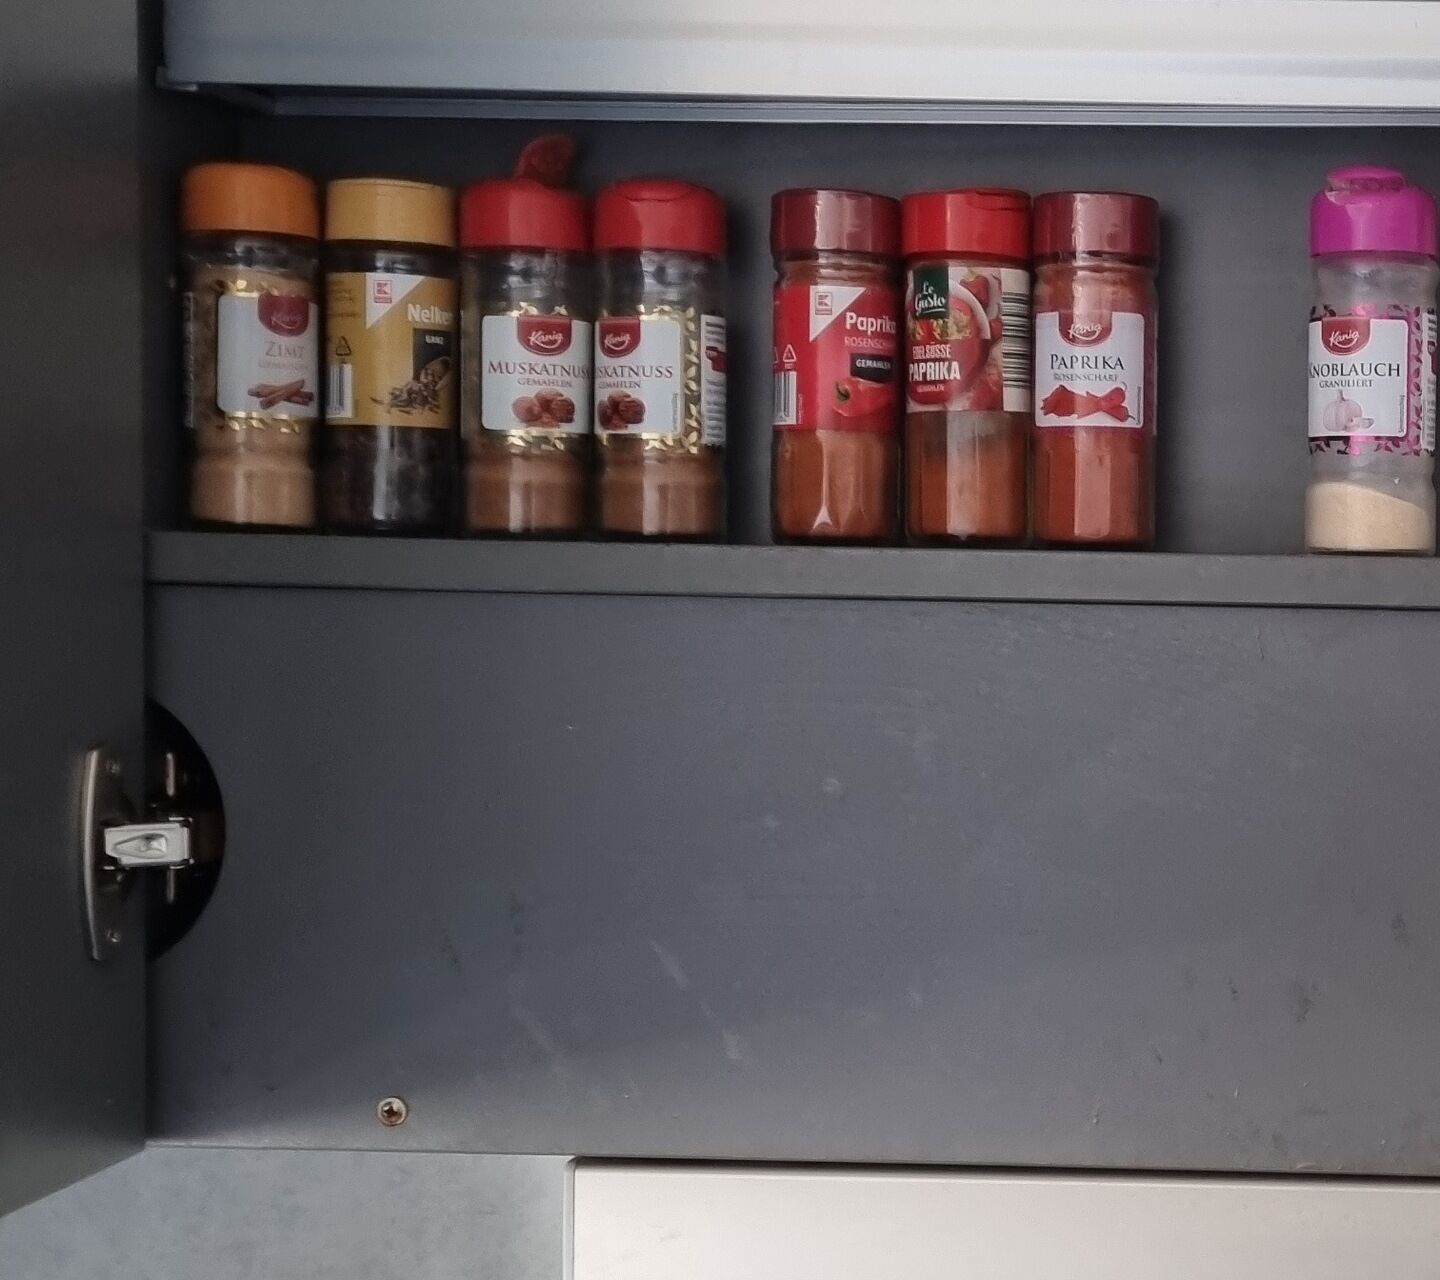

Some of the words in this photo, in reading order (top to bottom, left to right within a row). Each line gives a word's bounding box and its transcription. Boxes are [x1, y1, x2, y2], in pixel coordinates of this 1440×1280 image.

[408, 303, 454, 325] Nelke
[915, 293, 946, 317] Gusto
[909, 361, 961, 381] PAPRIKA
[1050, 354, 1124, 370] PAPRIKA
[1319, 380, 1373, 388] GRANULIERT
